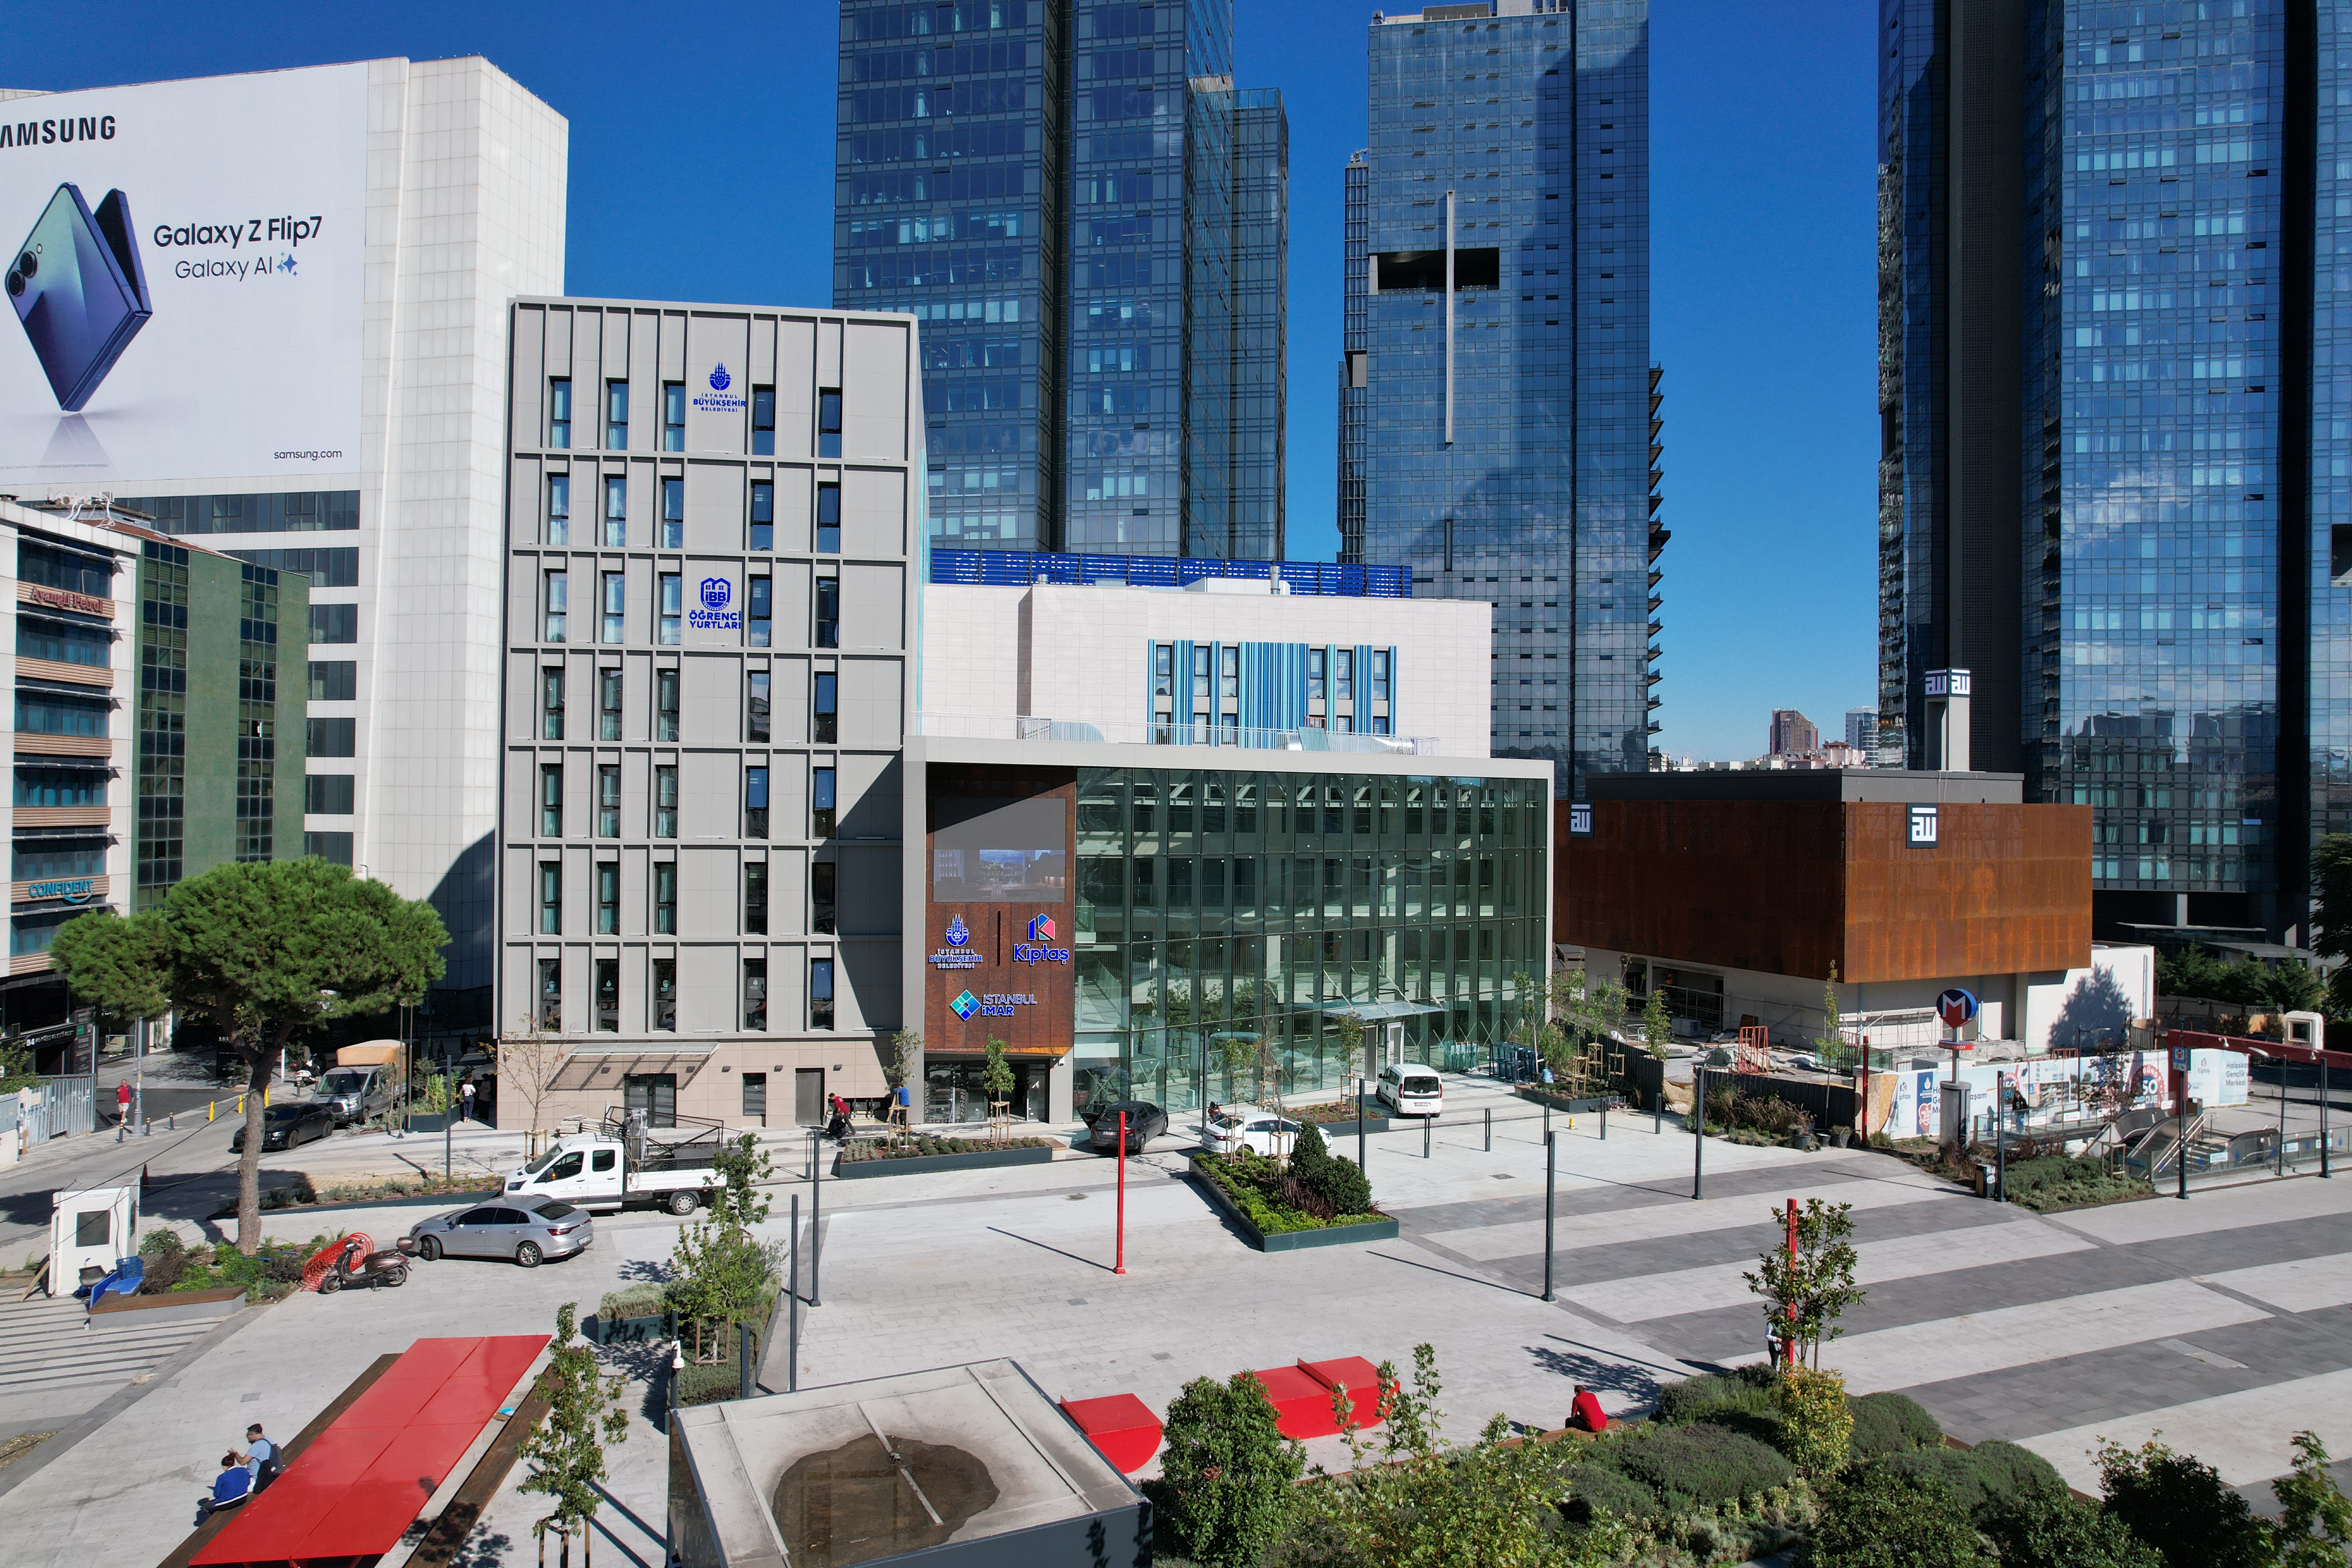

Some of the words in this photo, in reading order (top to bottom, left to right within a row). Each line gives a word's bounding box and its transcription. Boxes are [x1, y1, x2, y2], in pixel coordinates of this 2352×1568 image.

[0, 115, 115, 148] AMSUNG
[154, 223, 244, 249] Galaxy
[248, 219, 261, 242] Z
[268, 215, 322, 247] Flip7
[175, 259, 249, 282] Galaxy
[254, 256, 272, 275] AI
[693, 398, 746, 407] BÜYÜKŞEHİR
[274, 450, 342, 461] samsung.com
[31, 586, 70, 606] Ayangil
[73, 594, 103, 612] Petrol
[689, 609, 741, 621] ÖĞRENCİ
[689, 621, 741, 629] YURTLARI
[29, 880, 93, 897] CONFIDENT
[929, 953, 983, 963] BÜYÜKŞEHİR
[1014, 943, 1069, 965] Kiptaş
[1942, 993, 1966, 1019] M
[2226, 1070, 2245, 1078] Gençlik
[1970, 1093, 1987, 1101] aşam
